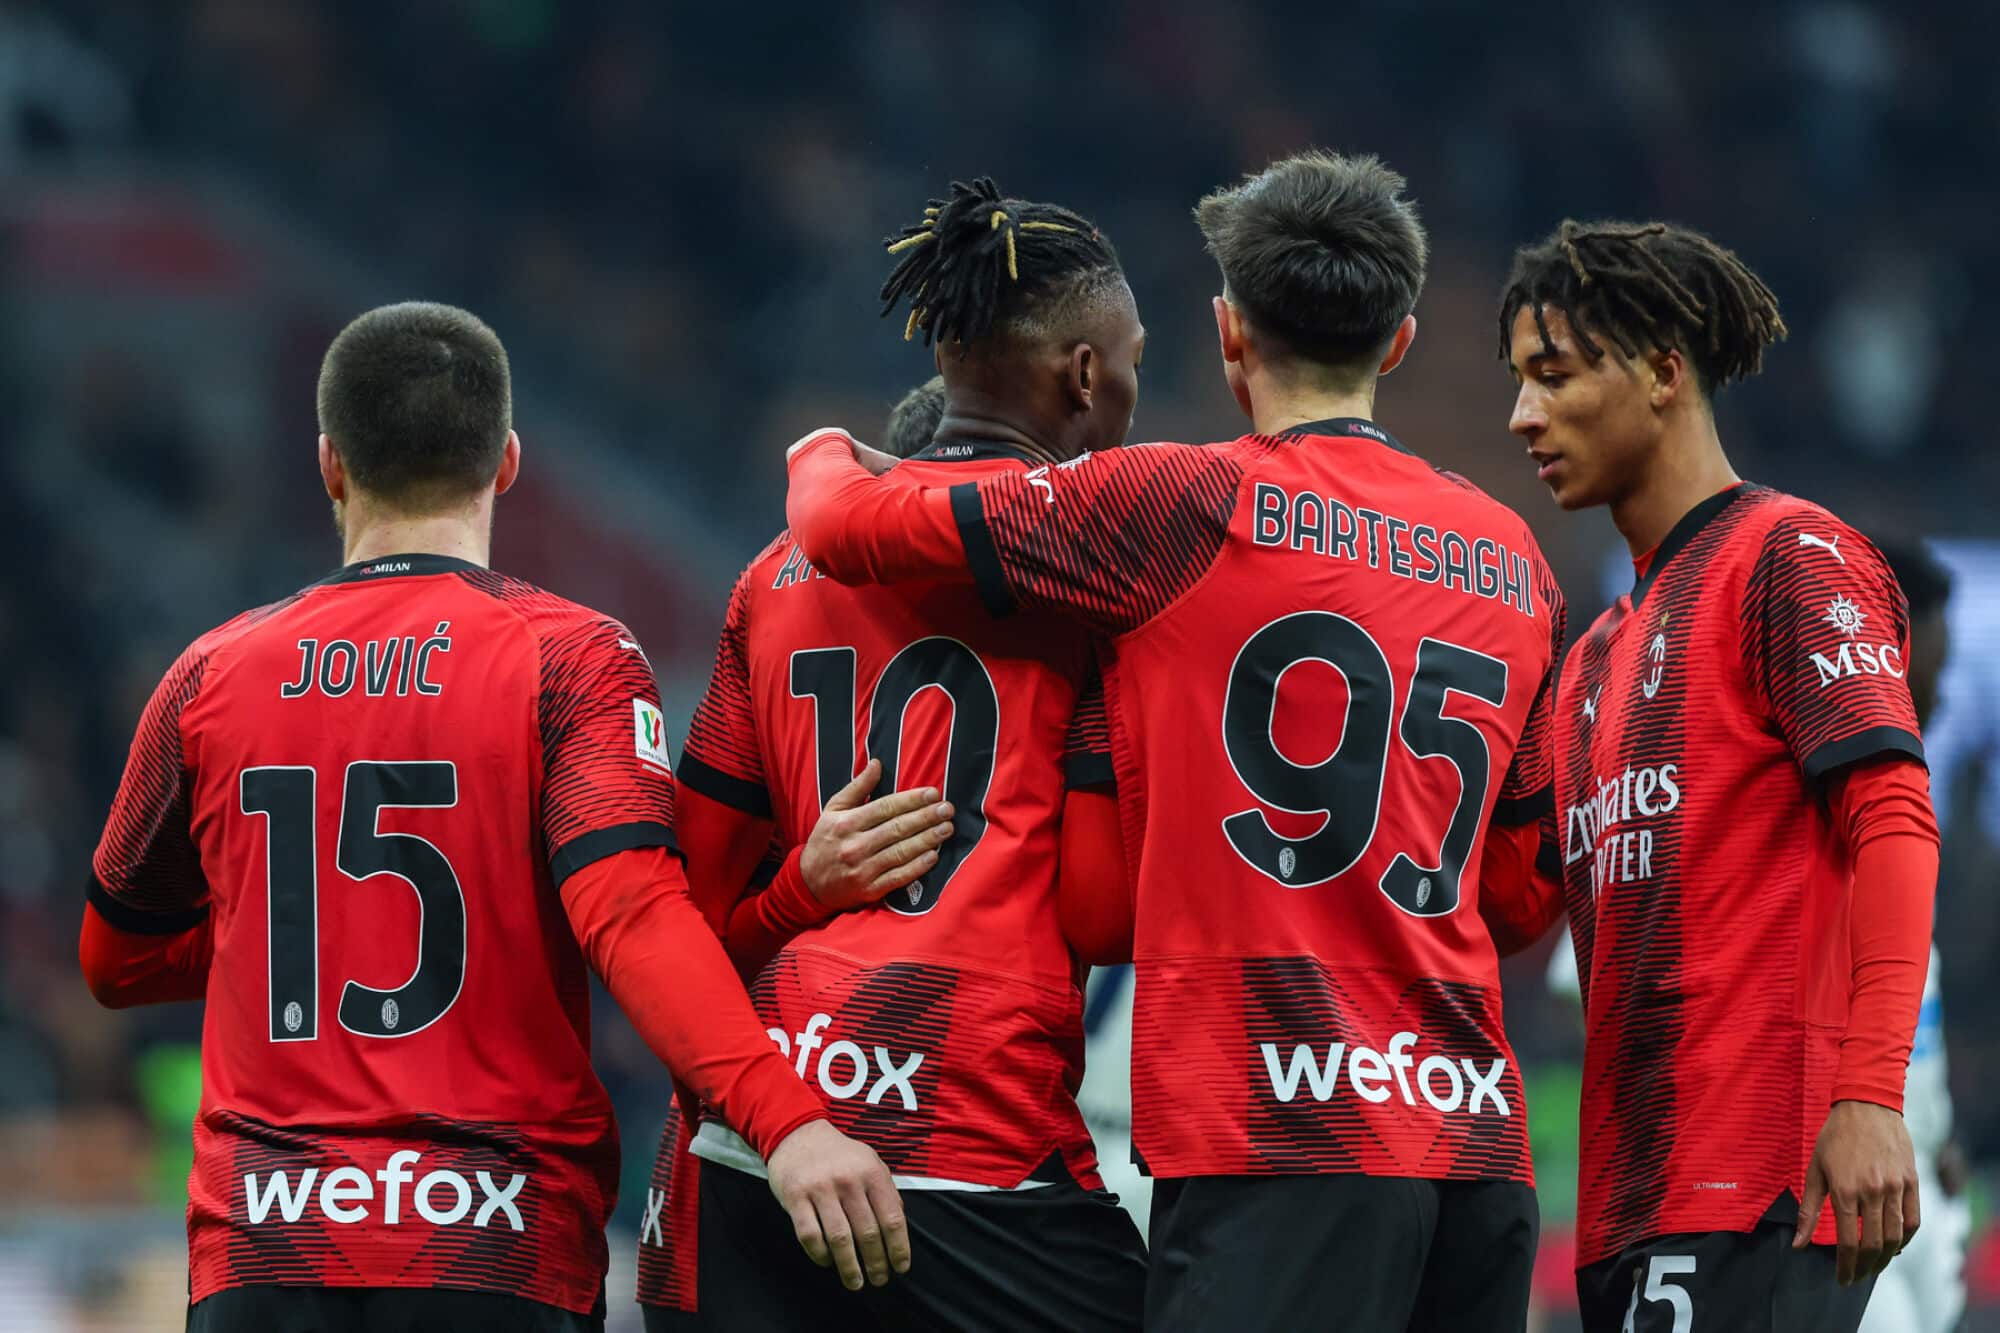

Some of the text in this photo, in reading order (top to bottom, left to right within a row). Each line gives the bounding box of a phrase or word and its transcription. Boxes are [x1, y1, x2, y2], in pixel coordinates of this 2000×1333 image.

[373, 562, 411, 574] MILAN
[1252, 481, 1535, 617] BARTESAGHI
[280, 620, 451, 698] JOVIĆ
[1809, 641, 1904, 688] MSC
[789, 635, 1000, 915] 10
[1221, 610, 1508, 917] 95
[239, 760, 467, 1042] 15
[766, 1012, 925, 1111] fox
[1260, 1031, 1511, 1116] wefox
[242, 1149, 527, 1232] wefox
